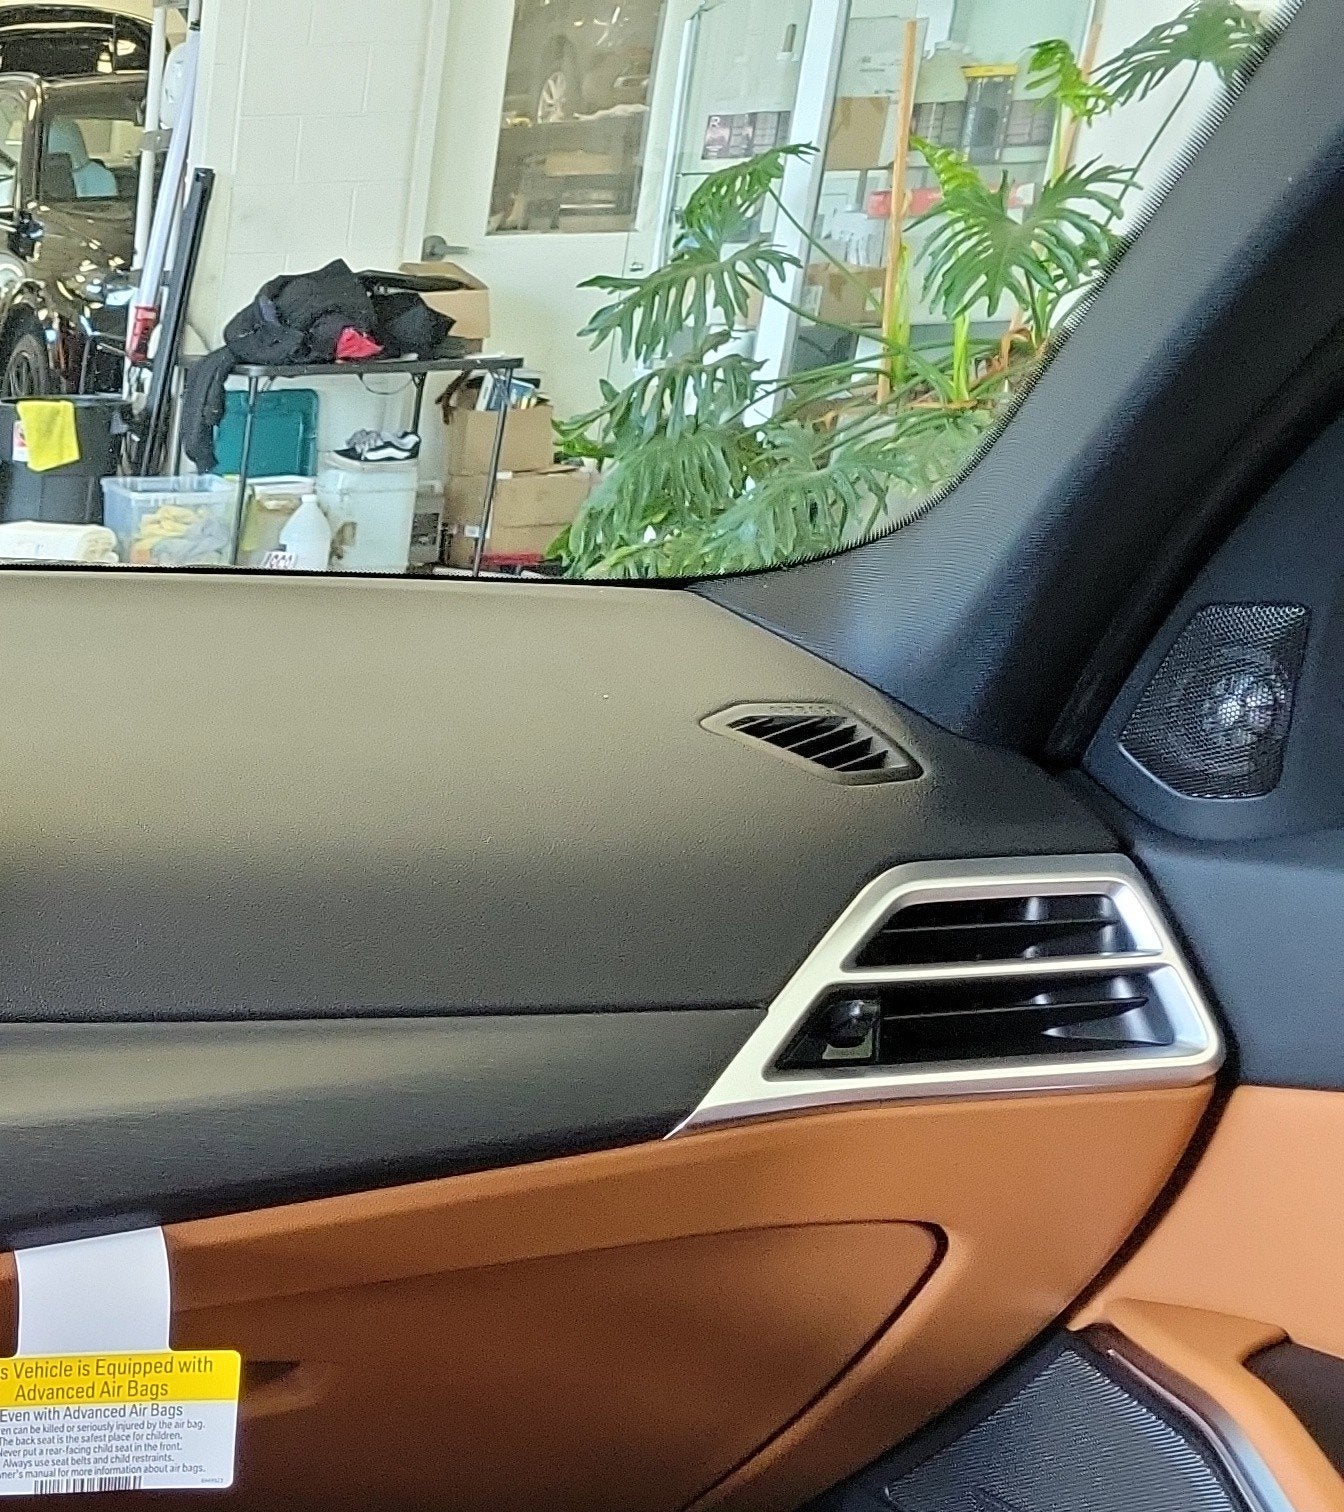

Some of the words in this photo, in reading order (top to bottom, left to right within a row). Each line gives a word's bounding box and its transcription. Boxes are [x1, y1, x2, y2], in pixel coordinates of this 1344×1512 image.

[13, 1361, 73, 1379] Vehicle
[78, 1360, 90, 1377] is
[95, 1356, 174, 1379] Equipped
[178, 1356, 213, 1373] with
[15, 1381, 95, 1401] Advanced
[99, 1380, 123, 1398] Air
[128, 1380, 168, 1400] Bags
[0, 1409, 30, 1423] Even
[33, 1407, 60, 1421] with
[63, 1404, 126, 1420] Advanced
[129, 1403, 148, 1418] Air
[151, 1403, 183, 1419] Bags
[13, 1427, 28, 1435] can
[30, 1425, 41, 1434] be
[43, 1423, 65, 1433] killed
[66, 1425, 75, 1433] or
[77, 1422, 113, 1433] seriously
[115, 1421, 145, 1432] injured
[146, 1420, 157, 1431] by
[158, 1420, 172, 1429] the
[174, 1420, 185, 1429] air
[187, 1419, 205, 1430] bag.
[15, 1436, 36, 1446] back
[37, 1435, 55, 1445] seat
[57, 1435, 64, 1444] is
[66, 1434, 79, 1444] the
[81, 1433, 106, 1443] safest
[108, 1432, 131, 1443] place
[132, 1431, 144, 1441] for
[23, 1447, 37, 1458] put
[45, 1445, 91, 1456] rear-facing
[93, 1444, 113, 1454] child
[115, 1443, 133, 1453] seat
[134, 1443, 142, 1452] in
[144, 1443, 158, 1452] the
[3, 1459, 33, 1470] Always
[34, 1459, 50, 1467] use
[51, 1457, 69, 1466] seat
[71, 1456, 91, 1466] belts
[93, 1455, 108, 1465] and
[110, 1454, 130, 1464] child
[132, 1453, 174, 1463] restraints.
[25, 1468, 56, 1478] manual
[58, 1468, 69, 1477] for
[71, 1468, 92, 1477] more
[94, 1465, 142, 1475] information
[143, 1464, 168, 1474] about
[170, 1464, 181, 1473] air
